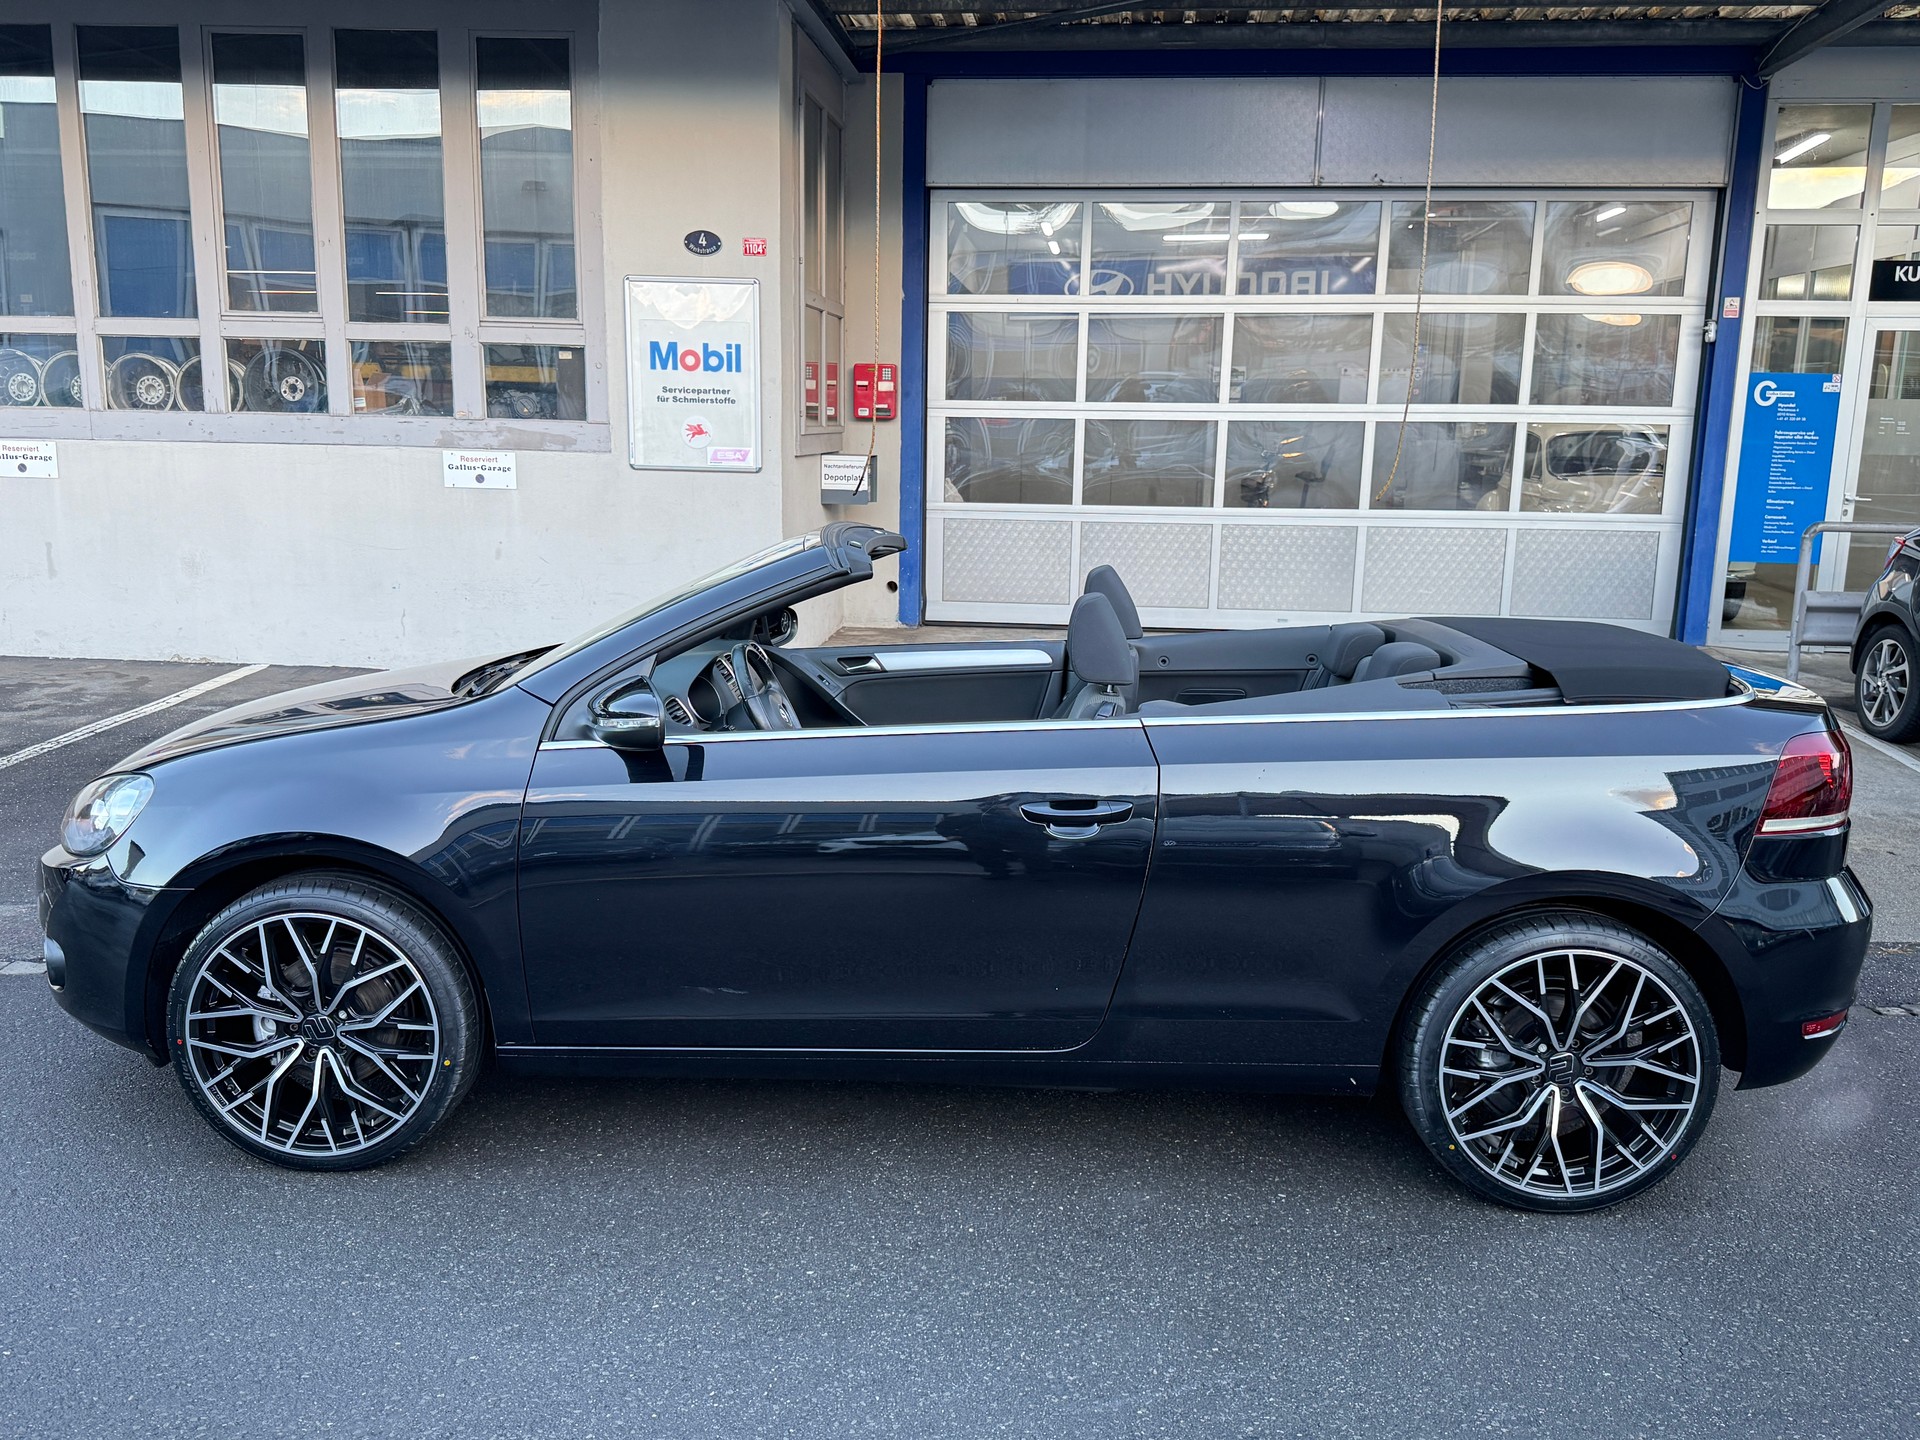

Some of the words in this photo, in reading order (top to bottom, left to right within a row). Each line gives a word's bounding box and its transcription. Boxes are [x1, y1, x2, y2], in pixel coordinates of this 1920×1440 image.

[698, 232, 707, 247] 4
[687, 242, 718, 255] Werkstrasse
[746, 243, 763, 254] 1104
[1894, 265, 1920, 282] KU
[1147, 270, 1329, 296] HYUNDAI
[649, 341, 742, 373] Mobil
[662, 386, 731, 396] Servicepartner
[672, 396, 736, 405] Schmierstoffe
[0, 453, 53, 461] llus-Garage
[460, 455, 498, 463] Reserviert
[447, 463, 512, 472] Gallus-Garage
[389, 928, 417, 951] STAR
